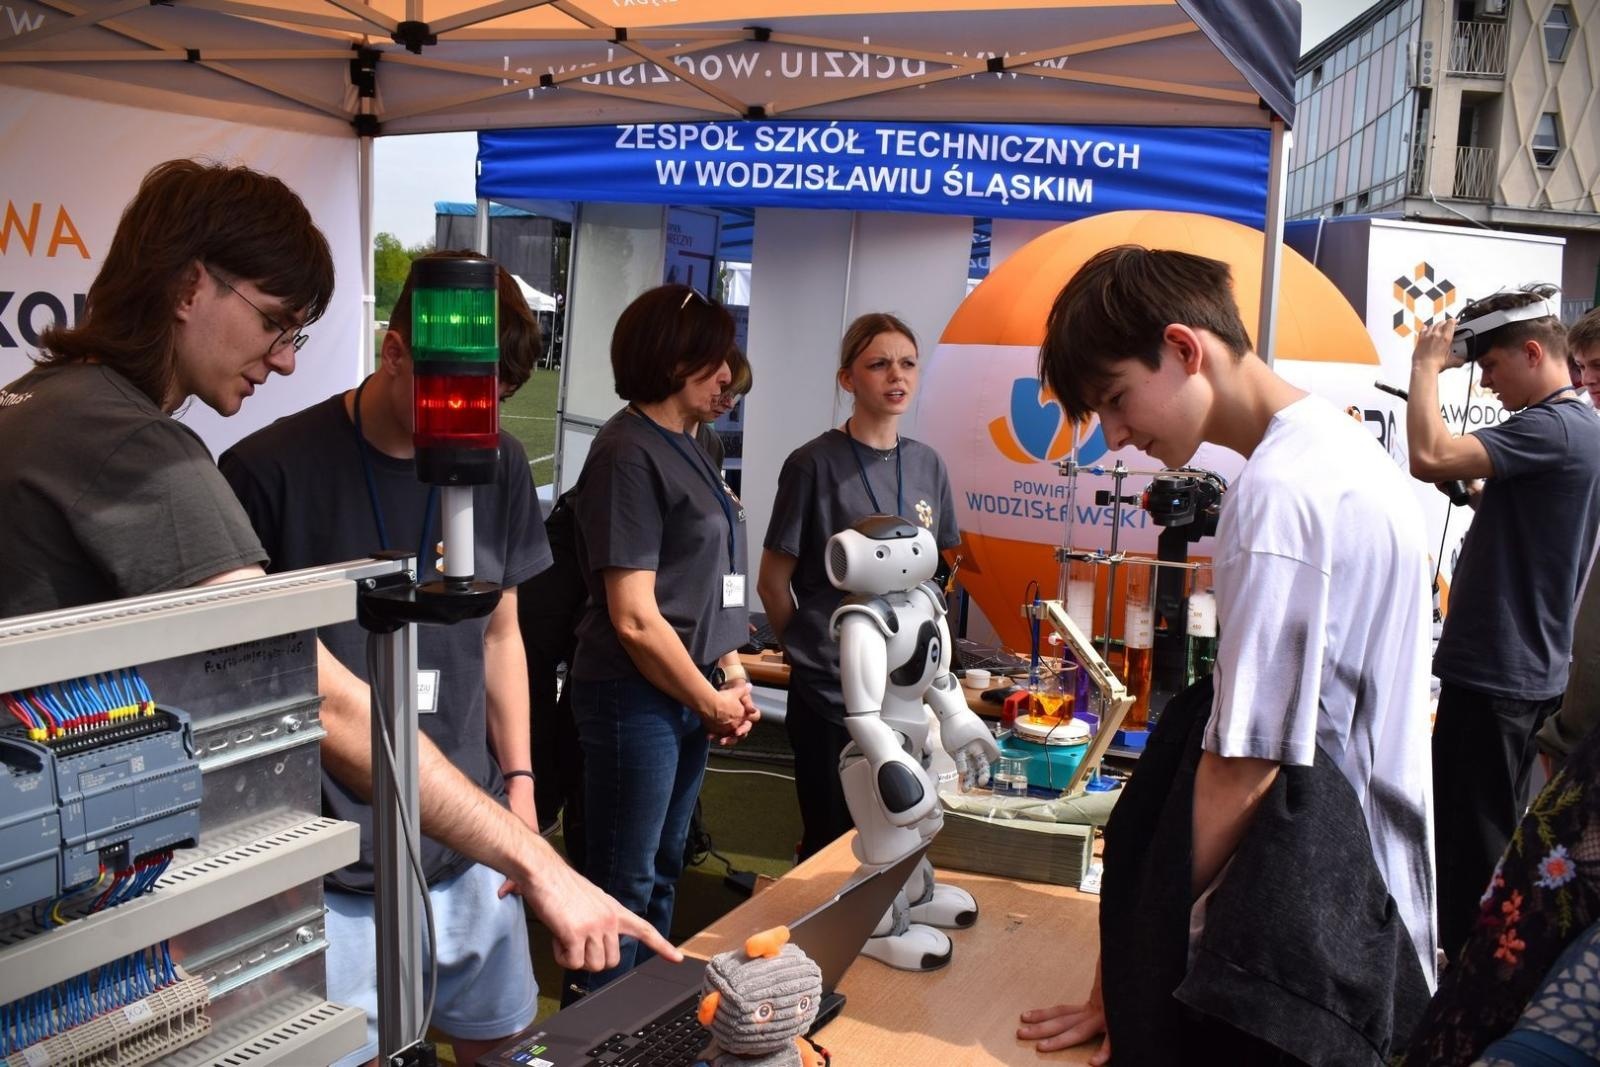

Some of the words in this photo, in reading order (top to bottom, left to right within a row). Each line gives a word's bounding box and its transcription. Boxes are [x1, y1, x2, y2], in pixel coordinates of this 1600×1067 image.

[615, 122, 745, 151] ZESPÓŁ
[754, 121, 865, 155] SZKÓŁ
[875, 129, 1140, 170] TECHNICZNYCH
[655, 159, 687, 186] W
[695, 160, 932, 195] WODZISŁAWIU
[943, 164, 1093, 206] ŚLĄSKIM
[965, 491, 1147, 530] WODZISŁAWSKI
[1013, 480, 1078, 499] POWIAT
